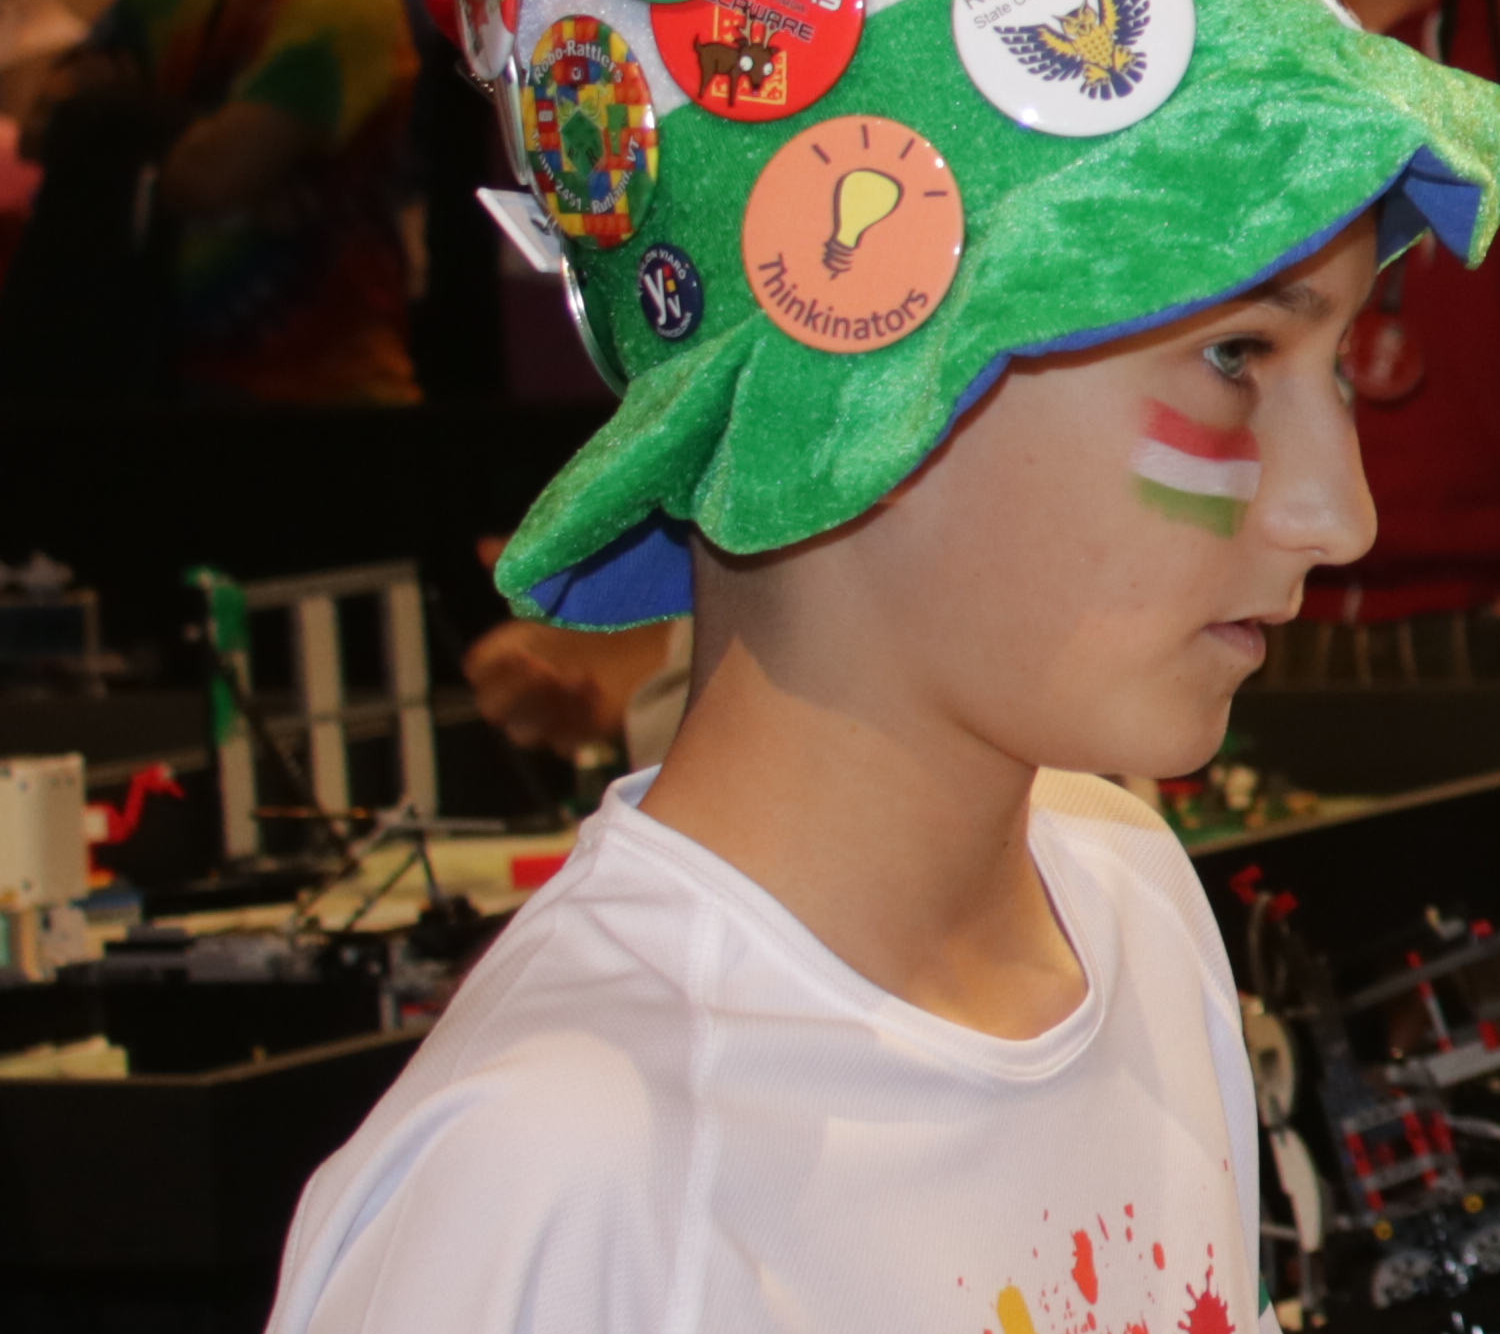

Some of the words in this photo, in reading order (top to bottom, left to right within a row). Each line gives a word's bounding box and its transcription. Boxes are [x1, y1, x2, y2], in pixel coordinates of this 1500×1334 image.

[974, 1, 1013, 30] State
[532, 39, 623, 84] Robo-Rattlers
[555, 178, 584, 210] 2451
[627, 135, 640, 163] VT
[758, 251, 930, 341] Thinkinators
